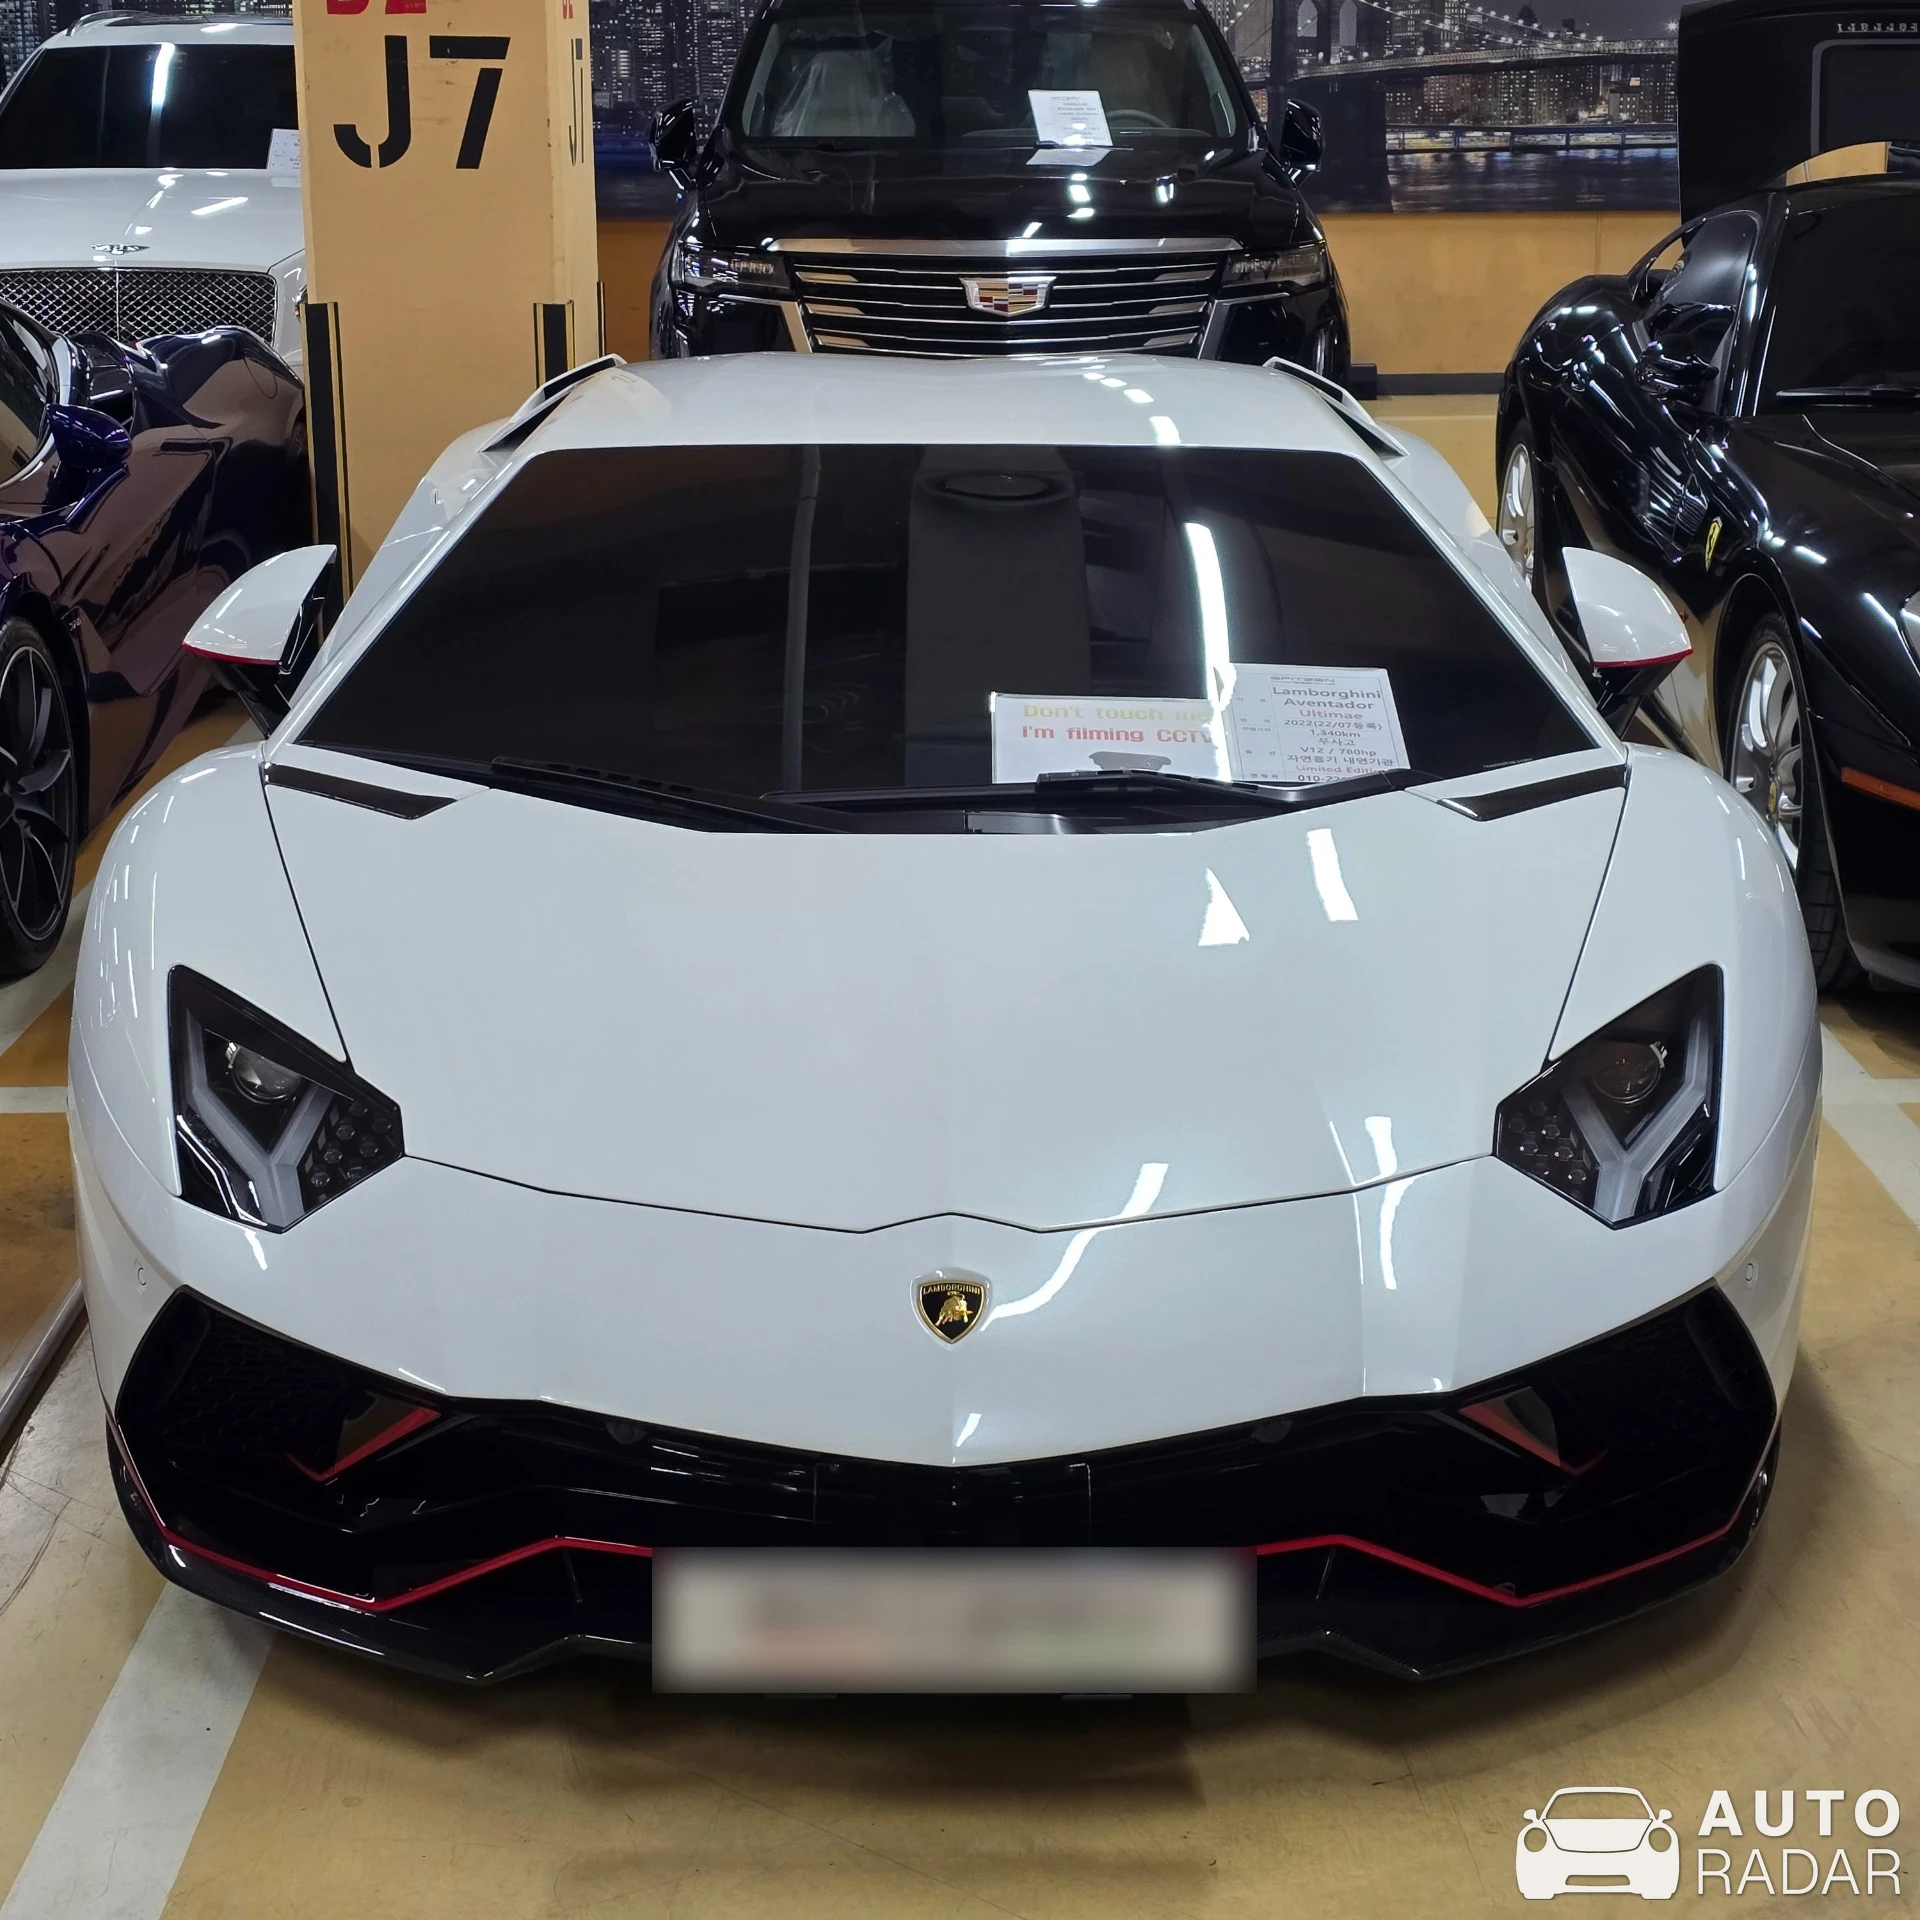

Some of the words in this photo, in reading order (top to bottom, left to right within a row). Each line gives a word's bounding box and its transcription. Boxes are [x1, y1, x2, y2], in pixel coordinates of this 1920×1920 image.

[1837, 22, 1919, 33] Ferrari
[334, 35, 511, 169] J7
[1272, 686, 1382, 699] Lamborghini
[1283, 697, 1375, 709] Aventador
[1023, 705, 1084, 718] Don't
[1095, 707, 1164, 720] touch
[1299, 708, 1363, 719] Ultimae
[1022, 725, 1055, 738] I'm
[1066, 727, 1144, 742] filming
[1309, 729, 1361, 738] 1,340km
[1317, 737, 1356, 746] 무사고
[1339, 748, 1377, 757] 780hp
[1343, 756, 1394, 767] 내연기관
[1296, 764, 1342, 773] Limited
[923, 1283, 981, 1295] LAMBORGHINI
